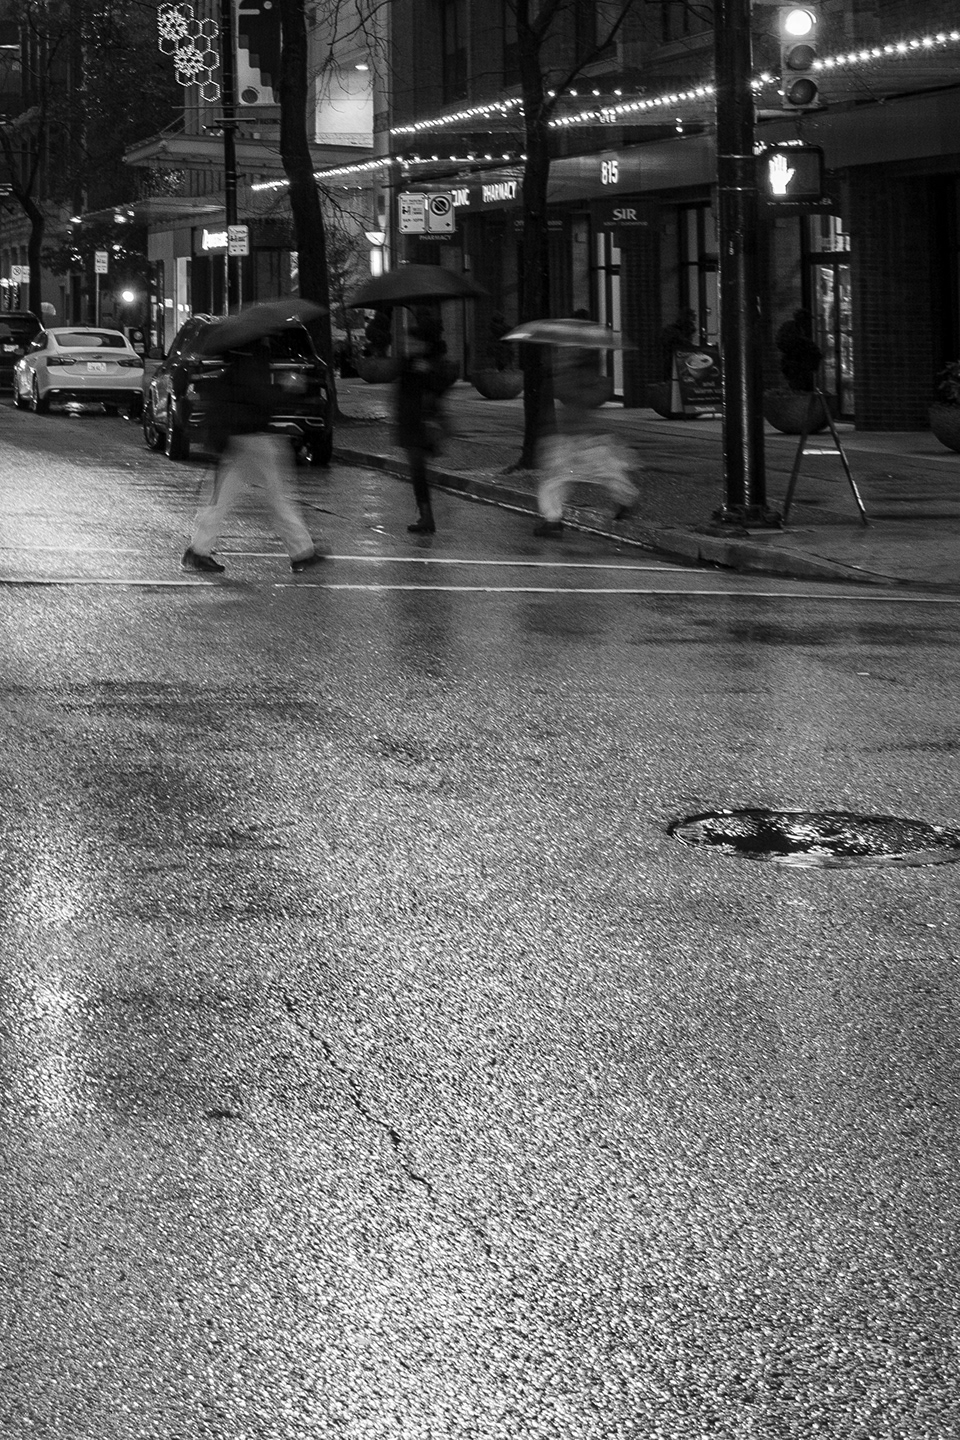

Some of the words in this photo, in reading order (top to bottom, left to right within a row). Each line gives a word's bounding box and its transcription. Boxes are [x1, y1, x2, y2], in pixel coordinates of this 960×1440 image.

[600, 160, 619, 185] 815
[482, 181, 518, 203] PHARMACY
[612, 208, 638, 221] SIR
